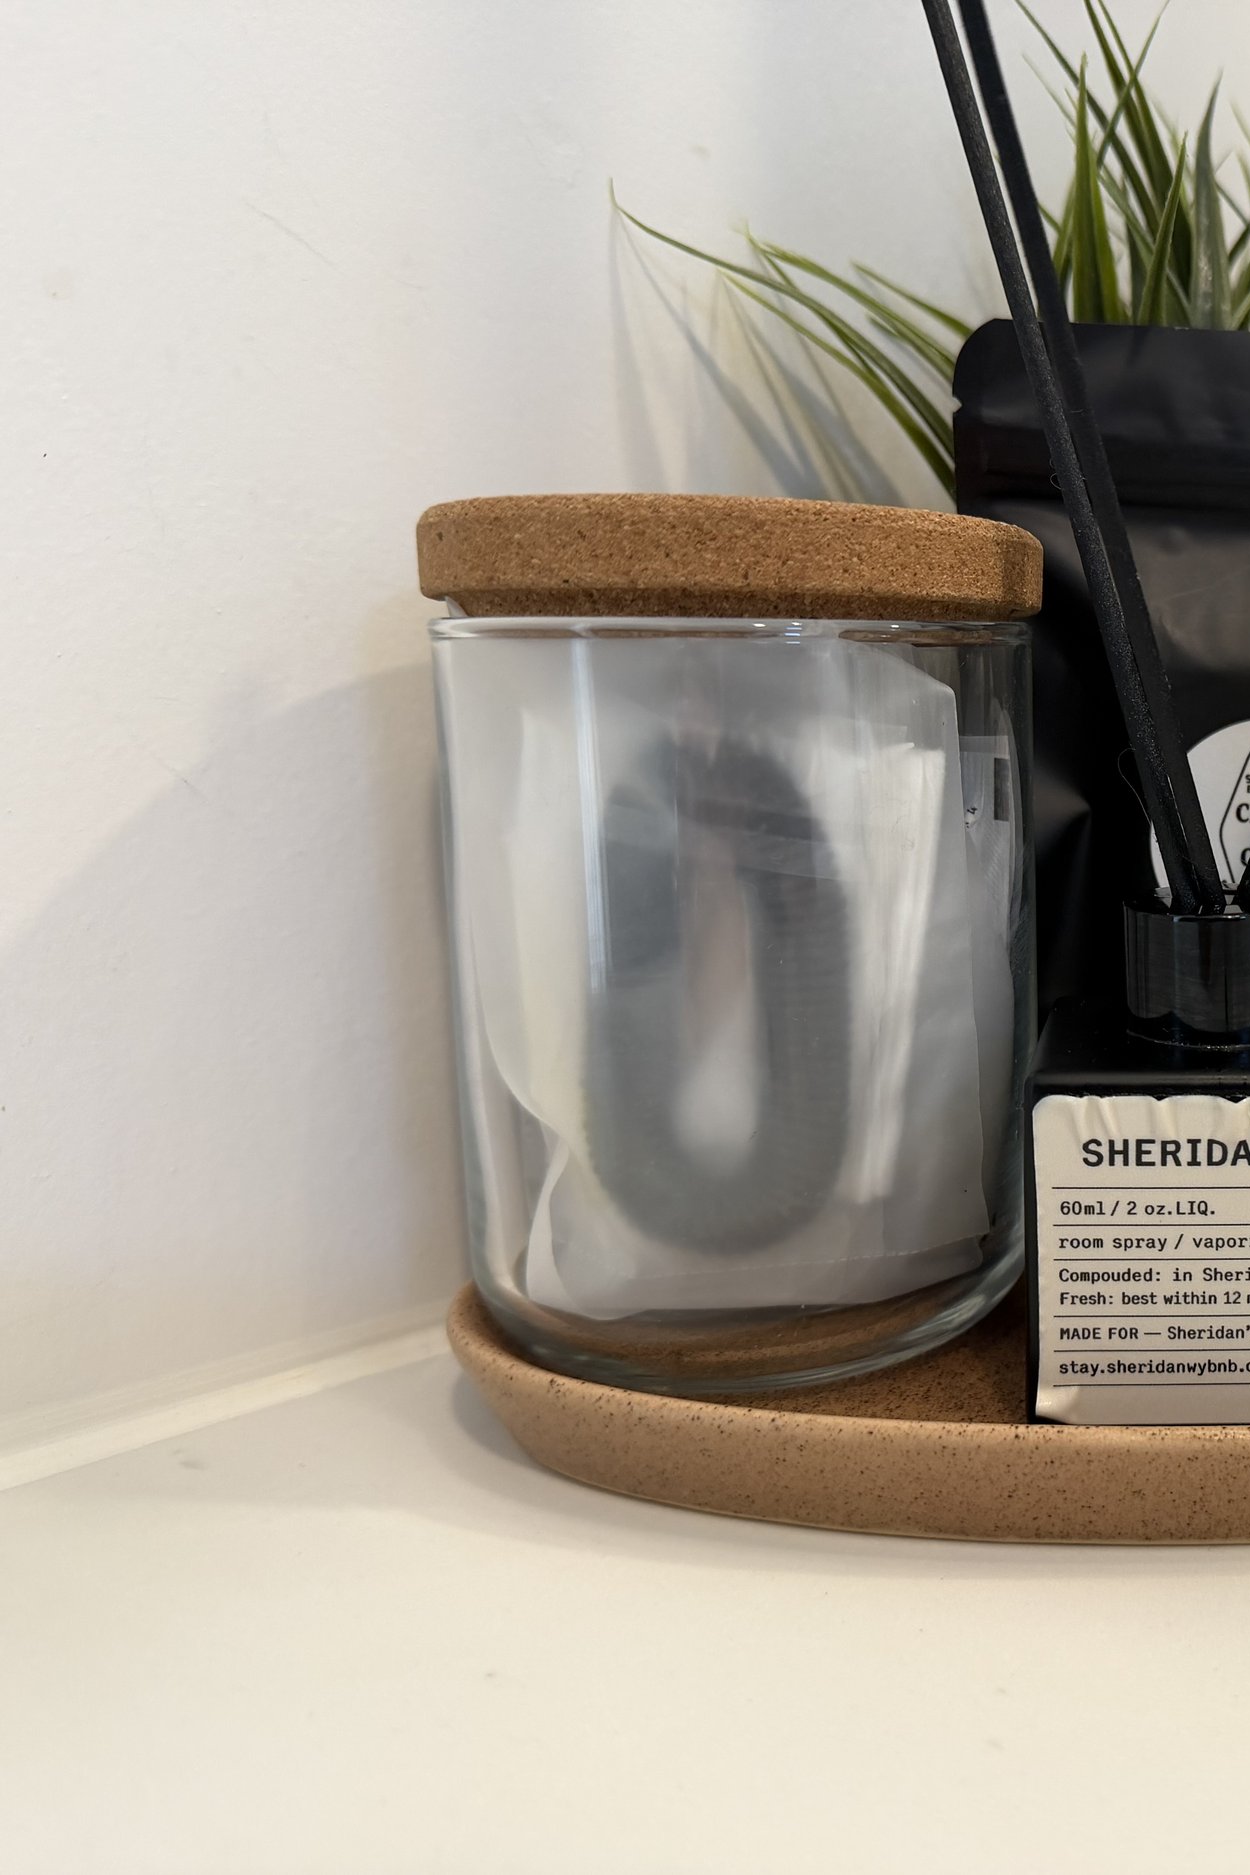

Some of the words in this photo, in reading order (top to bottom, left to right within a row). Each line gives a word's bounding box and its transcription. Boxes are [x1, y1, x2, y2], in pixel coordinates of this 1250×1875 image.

[1126, 1200, 1138, 1216] 2
[1058, 1237, 1104, 1250] room
[1112, 1237, 1168, 1253] spray
[1058, 1267, 1161, 1285] Compouded:
[1172, 1267, 1193, 1282] in
[1059, 1291, 1114, 1306] Fresh:
[1121, 1291, 1158, 1306] best
[1162, 1290, 1218, 1305] within
[1223, 1290, 1242, 1305] 12
[1059, 1326, 1102, 1341] MADE
[1107, 1326, 1139, 1341] FOR
